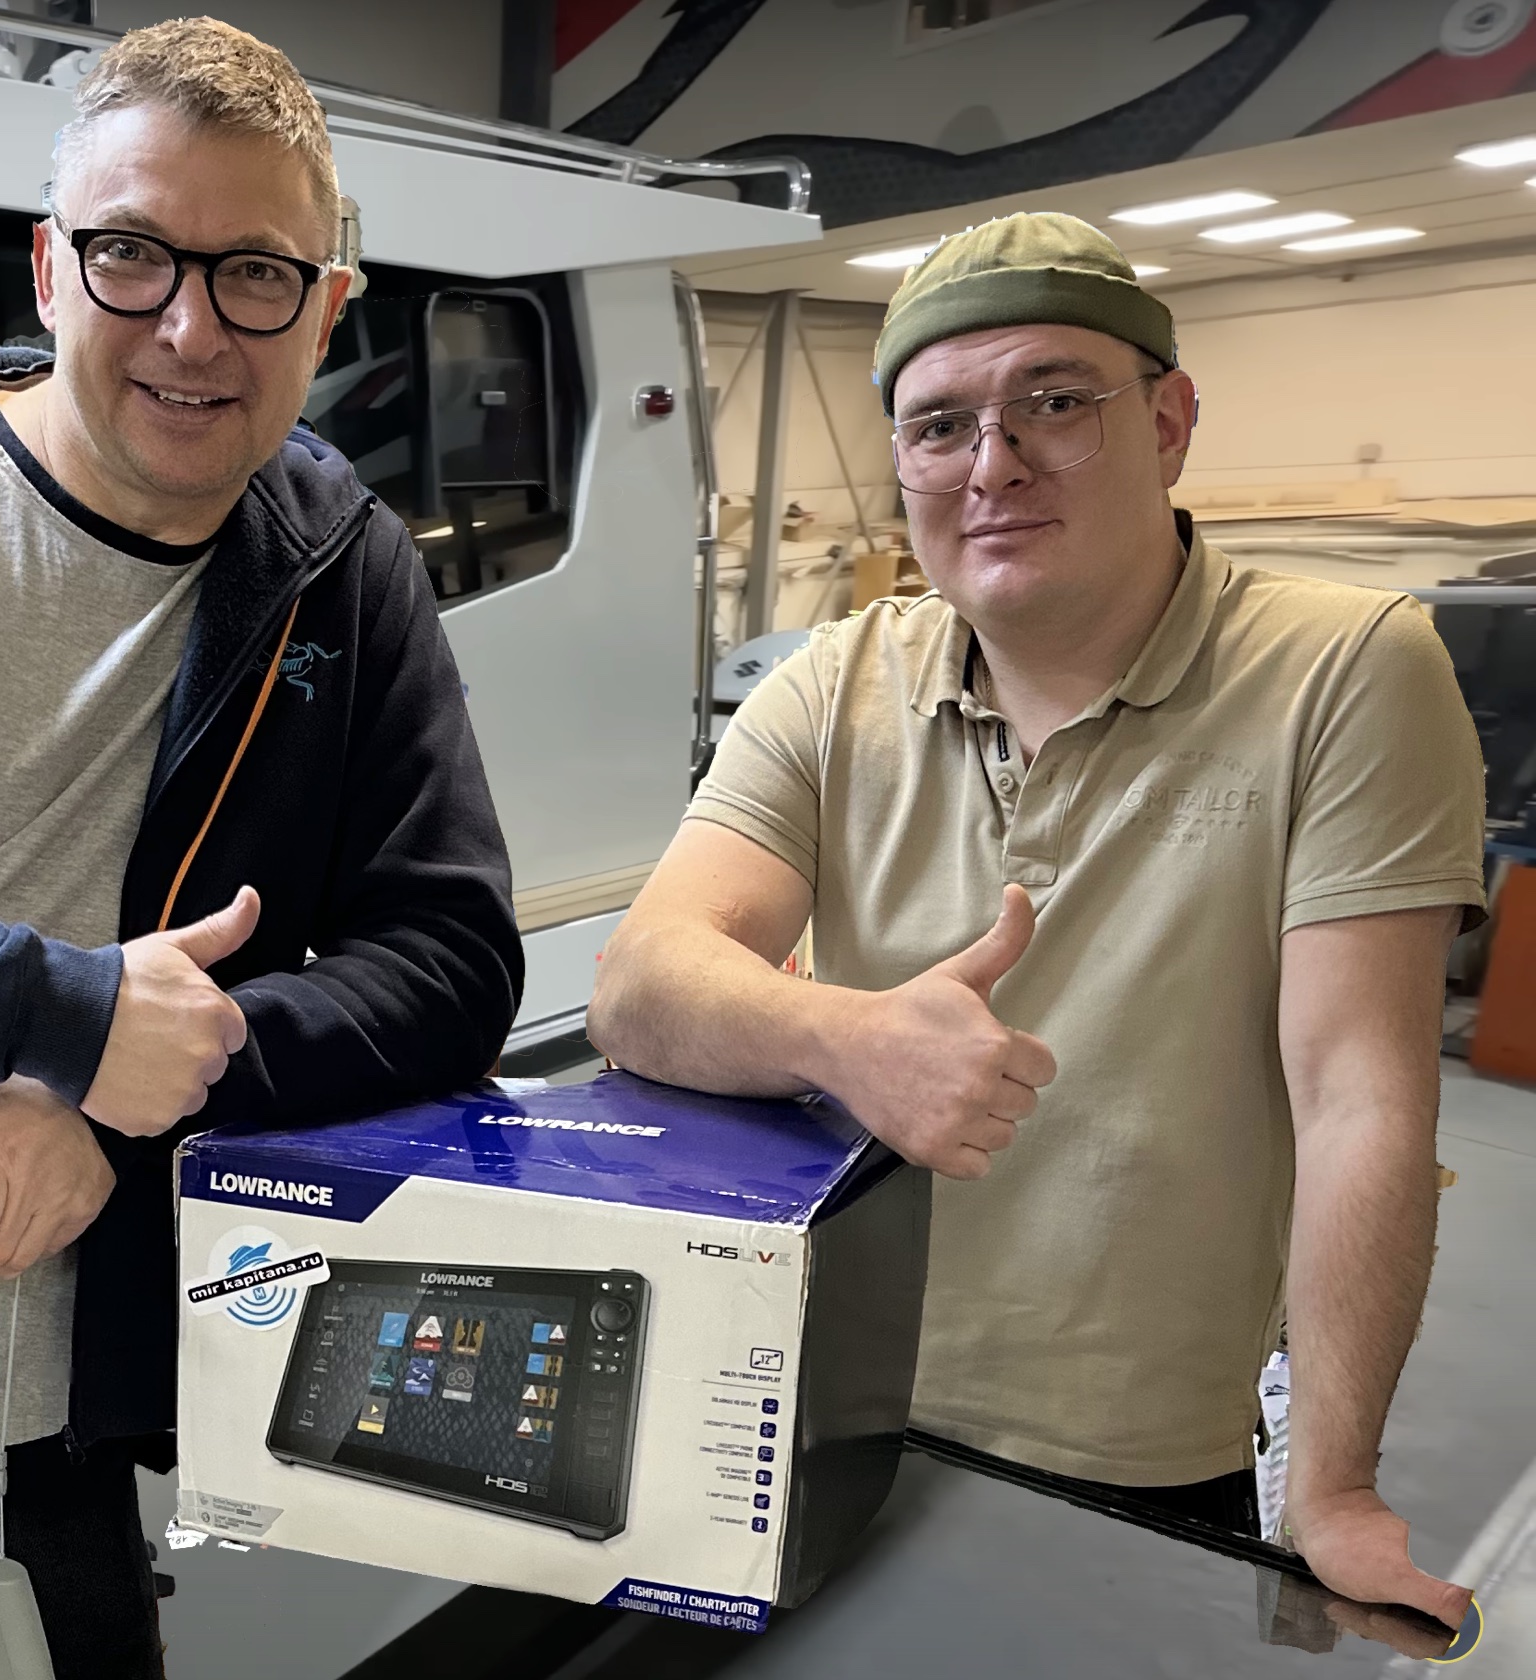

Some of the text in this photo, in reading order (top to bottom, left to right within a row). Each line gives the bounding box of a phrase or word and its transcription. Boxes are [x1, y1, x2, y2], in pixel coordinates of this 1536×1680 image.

[1123, 785, 1261, 811] OM TAILOR
[478, 1115, 666, 1137] LOWRANCE
[210, 1171, 333, 1207] LOWRANCE
[191, 1255, 321, 1300] mir kapitana.ru
[420, 1273, 494, 1287] LOWRANCE
[617, 1597, 660, 1614] SONDEUR
[668, 1606, 708, 1623] LECTEUR
[710, 1614, 722, 1626] DE
[628, 1584, 681, 1604] FISHFINDER
[689, 1595, 759, 1616] CHARTPLOTTER
